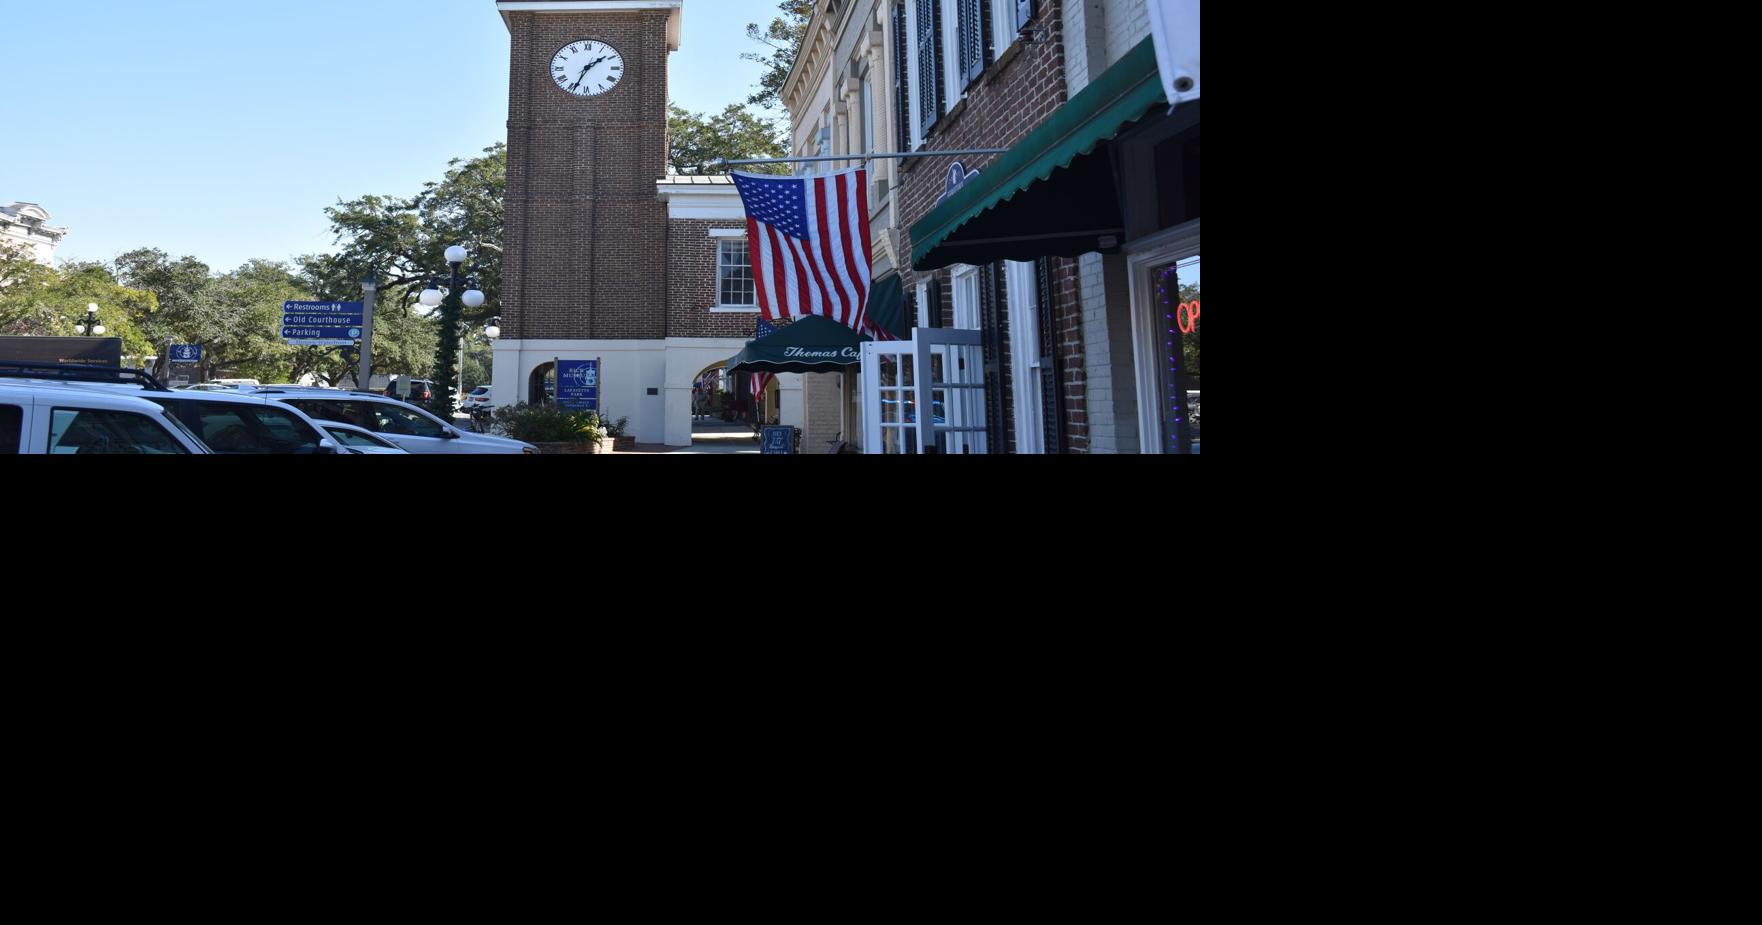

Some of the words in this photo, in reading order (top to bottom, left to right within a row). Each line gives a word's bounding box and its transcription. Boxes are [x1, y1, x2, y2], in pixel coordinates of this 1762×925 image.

[293, 303, 330, 311] Restrooms
[308, 316, 351, 324] Courthouse
[292, 328, 321, 337] Parking
[783, 346, 838, 358] Thomas
